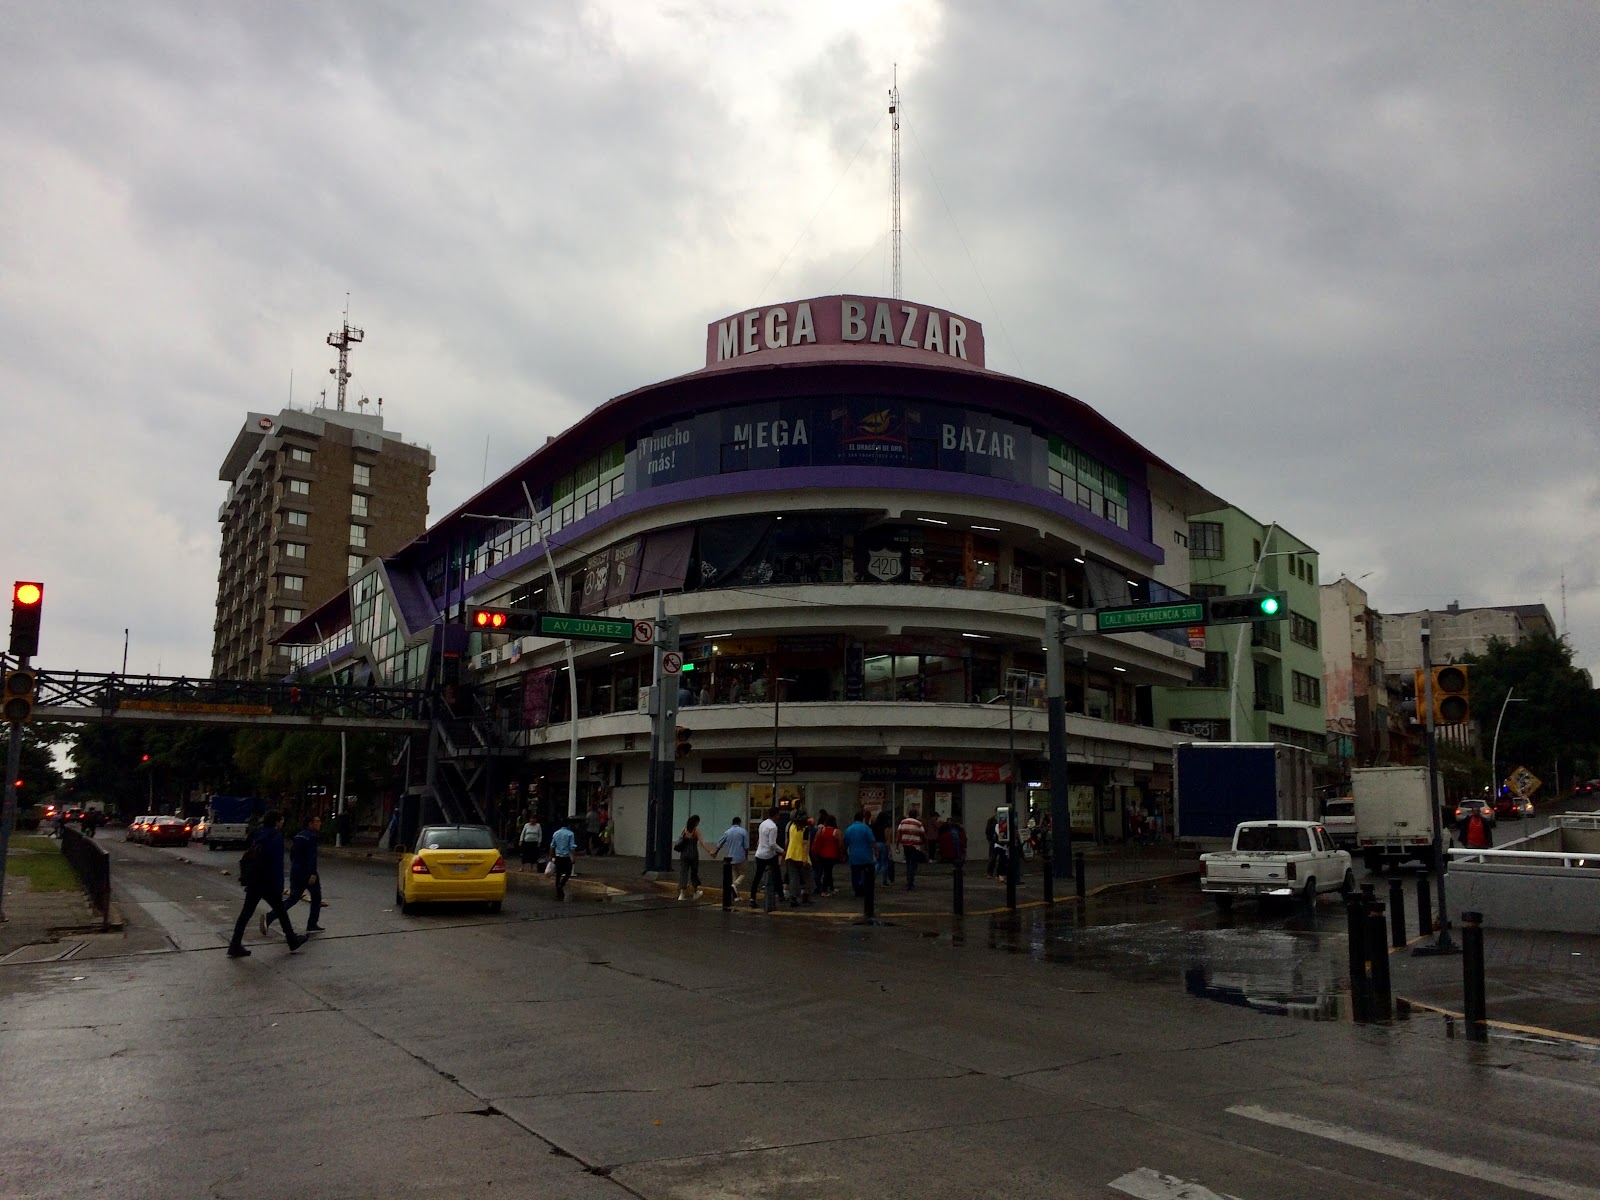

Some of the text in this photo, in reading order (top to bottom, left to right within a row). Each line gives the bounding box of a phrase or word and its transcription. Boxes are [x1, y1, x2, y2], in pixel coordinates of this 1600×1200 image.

[717, 300, 967, 362] MEGA BAZAR
[649, 427, 690, 453] mucho
[734, 419, 1015, 460] MEGA BAZAR
[647, 450, 676, 475] más!
[871, 558, 898, 576] 420
[1105, 608, 1197, 625] CALZ INDEPENDENCIA SUR
[553, 621, 622, 634] AV. JUAREZ
[759, 760, 792, 770] OXXO
[860, 790, 885, 799] OXXO
